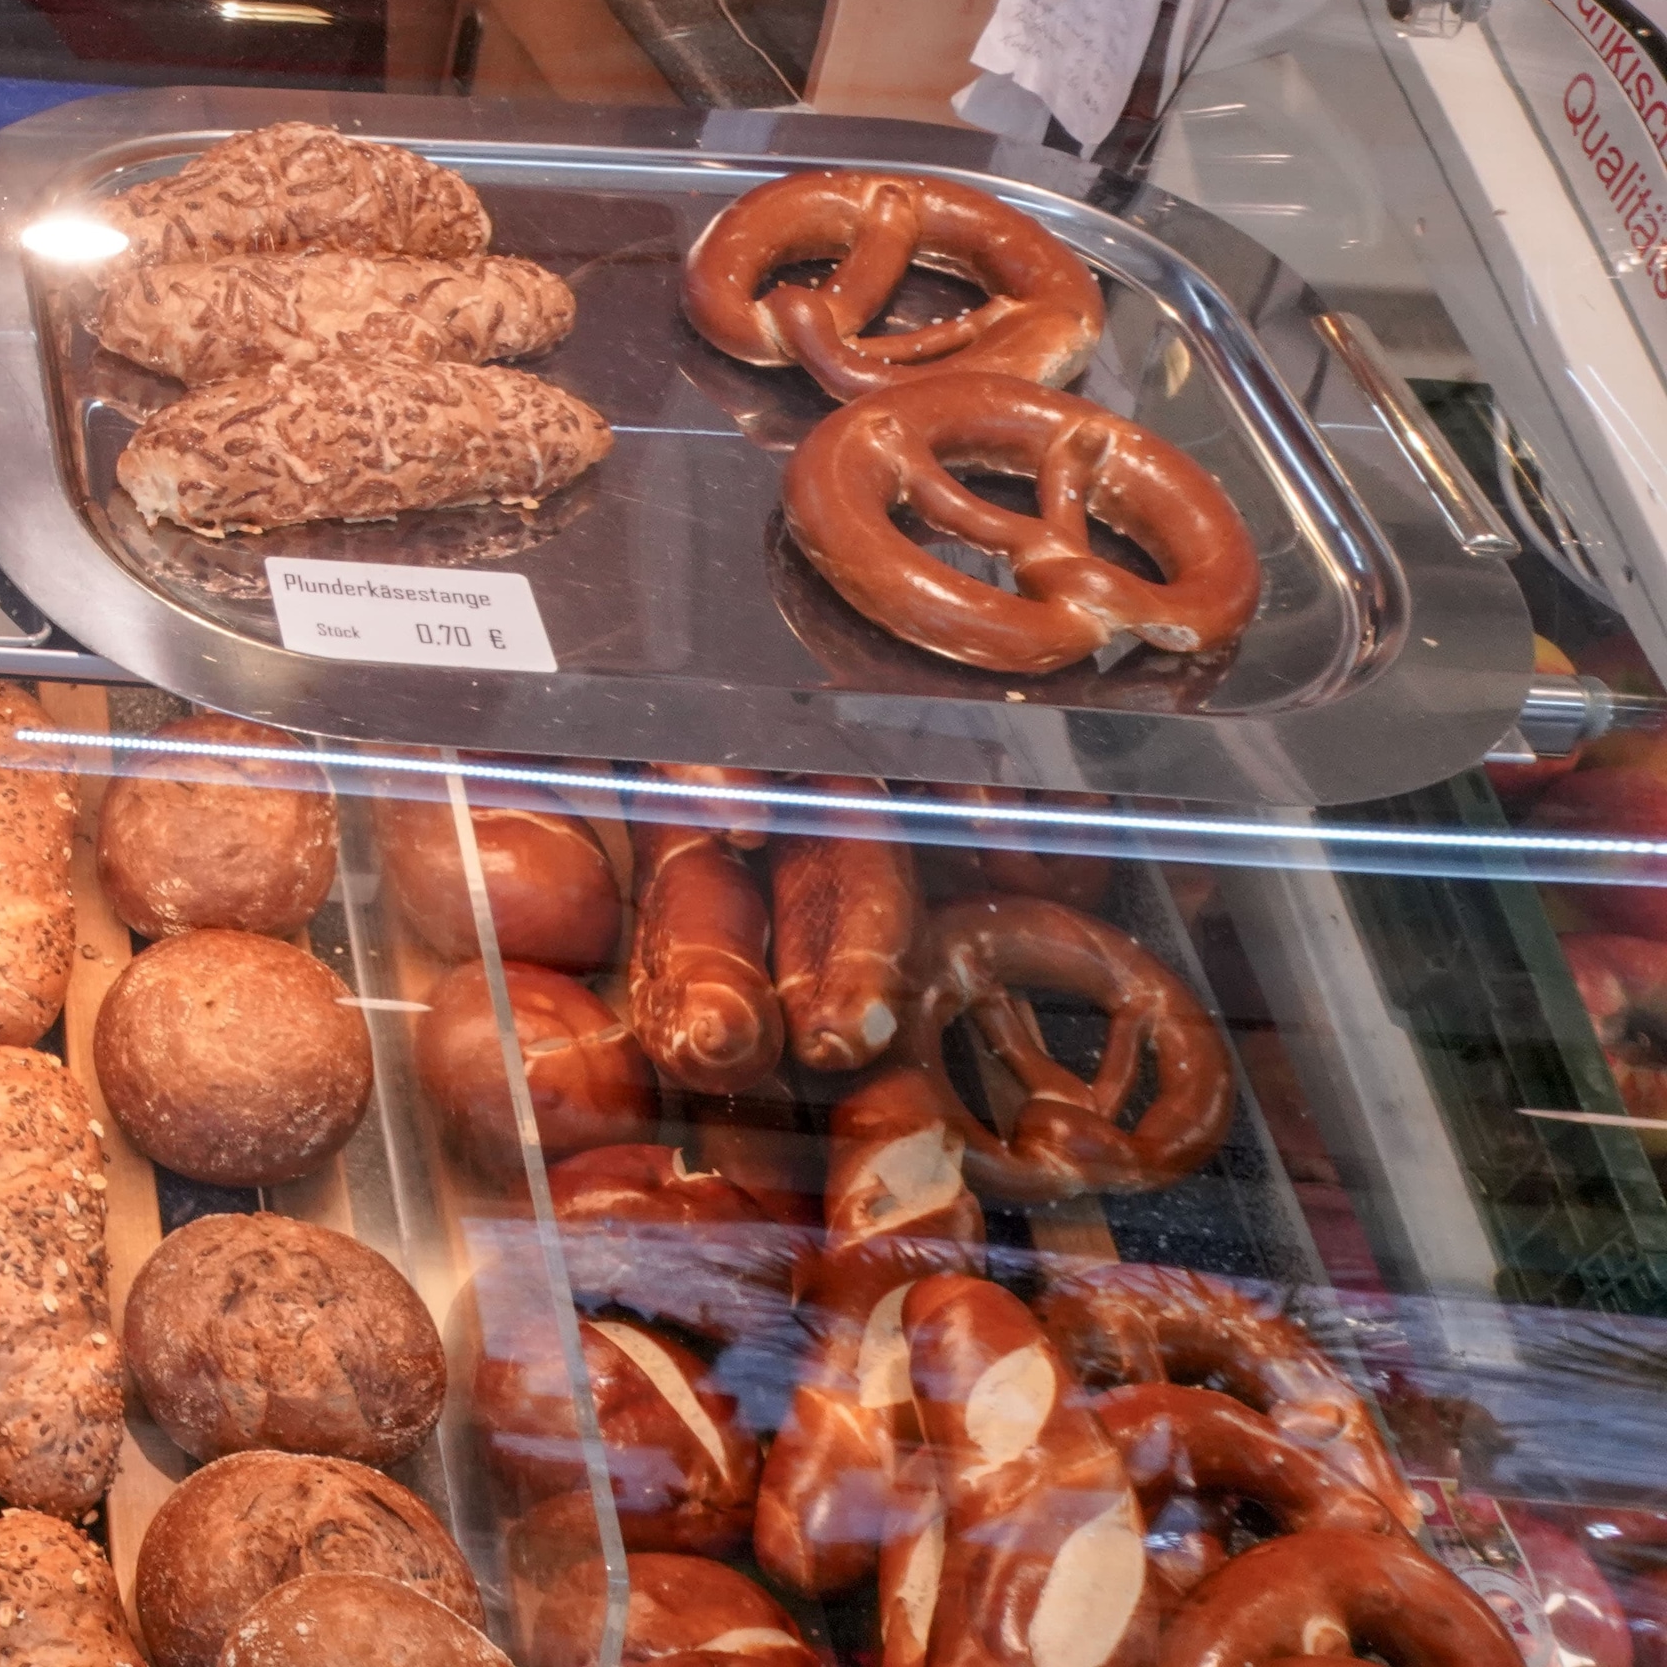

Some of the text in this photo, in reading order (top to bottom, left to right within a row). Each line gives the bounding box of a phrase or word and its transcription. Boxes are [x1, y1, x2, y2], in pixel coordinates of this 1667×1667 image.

[283, 573, 492, 609] Plunderkäsestange
[316, 622, 506, 650] Stück 0.70 €
